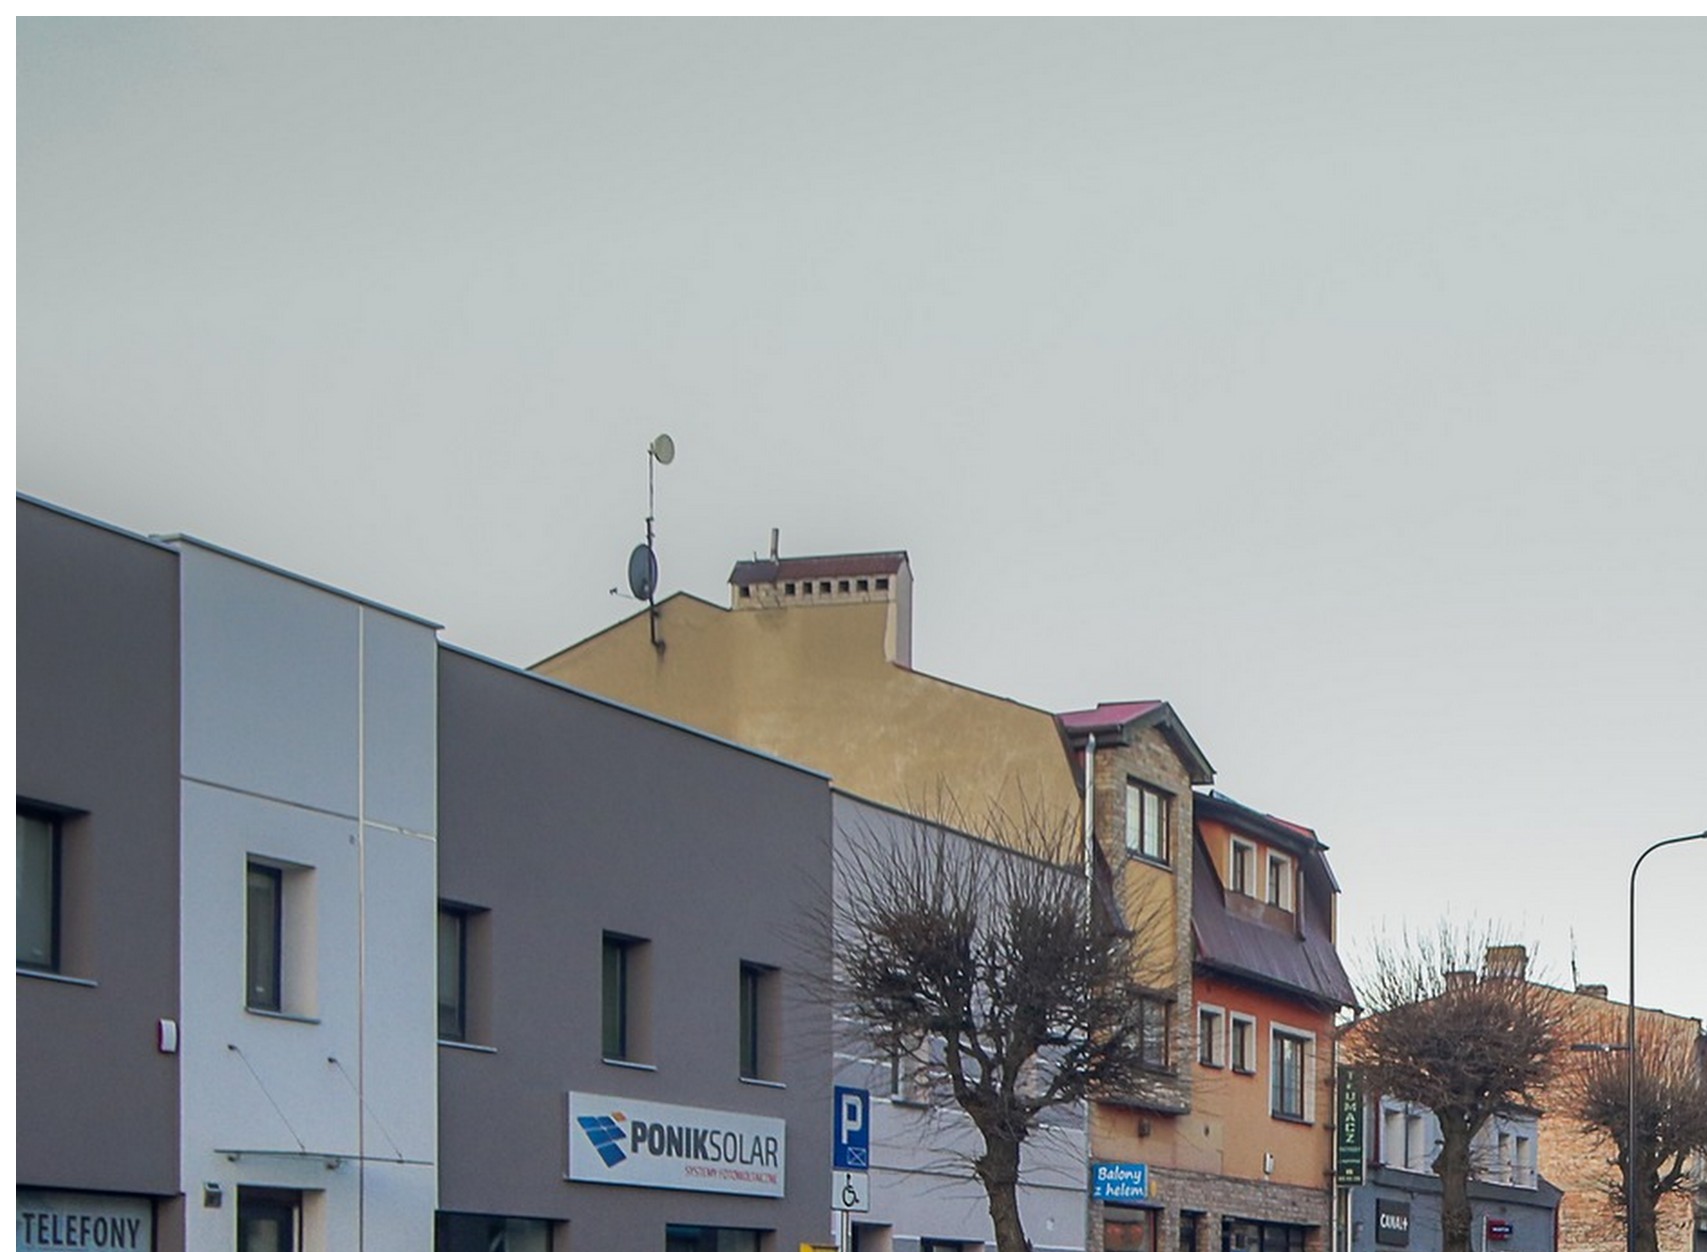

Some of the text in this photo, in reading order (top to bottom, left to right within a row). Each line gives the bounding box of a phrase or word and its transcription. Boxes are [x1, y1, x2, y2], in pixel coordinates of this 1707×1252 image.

[842, 1093, 862, 1145] P
[631, 1120, 778, 1168] PONIKSOLAR
[1093, 1182, 1145, 1197] z helem
[1097, 1165, 1142, 1185] Balony
[22, 1212, 141, 1249] TELEFONY
